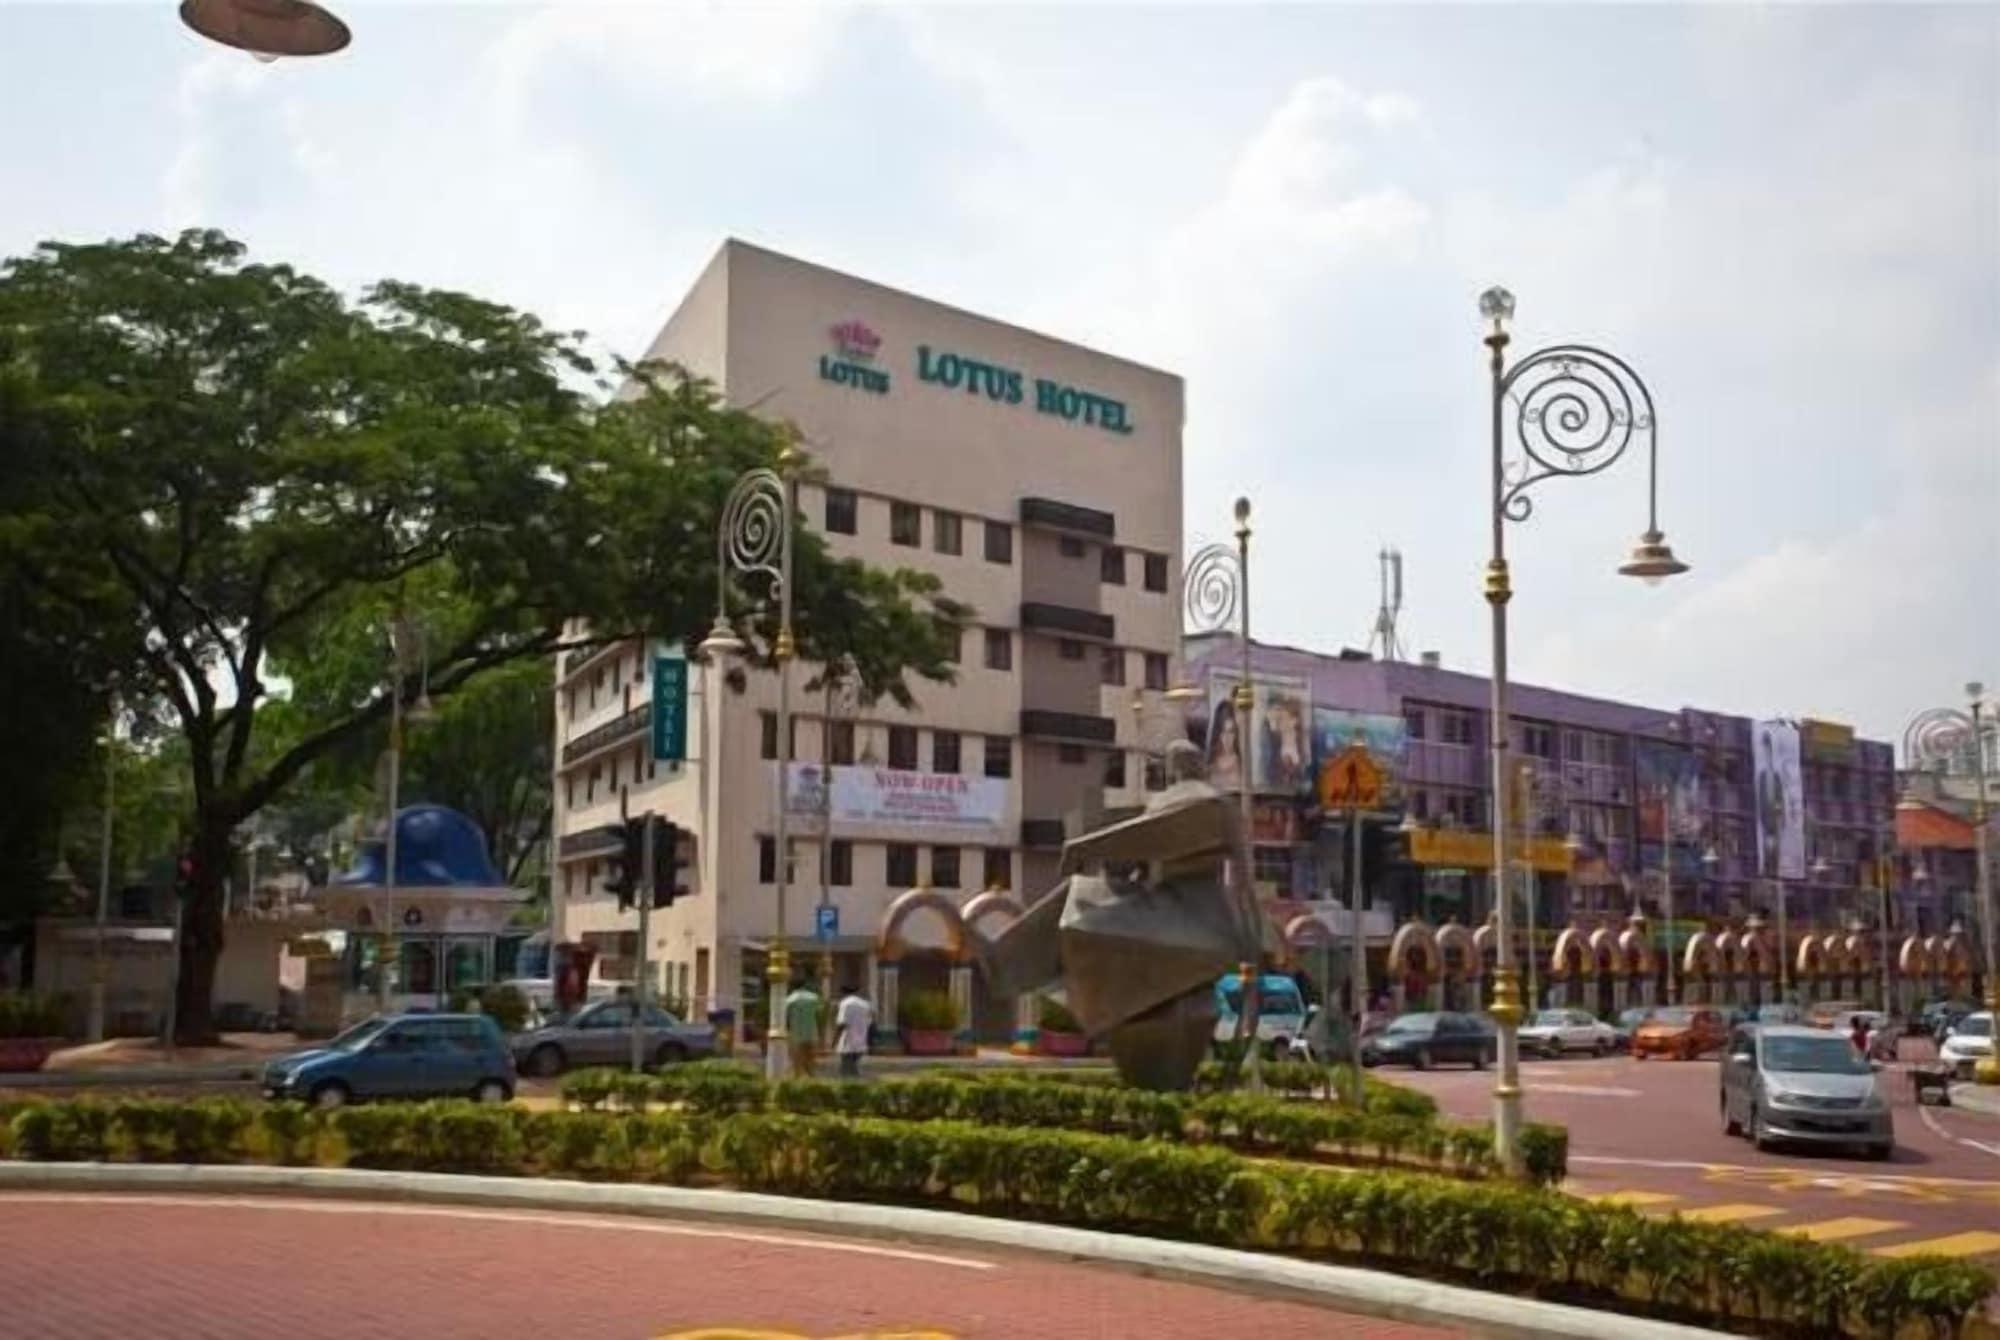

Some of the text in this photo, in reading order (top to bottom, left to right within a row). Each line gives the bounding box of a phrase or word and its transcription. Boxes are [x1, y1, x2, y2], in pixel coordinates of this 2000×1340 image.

[819, 354, 890, 394] LOTUS
[917, 345, 1134, 435] LOTUS HOTEL
[662, 668, 678, 753] HOTEL
